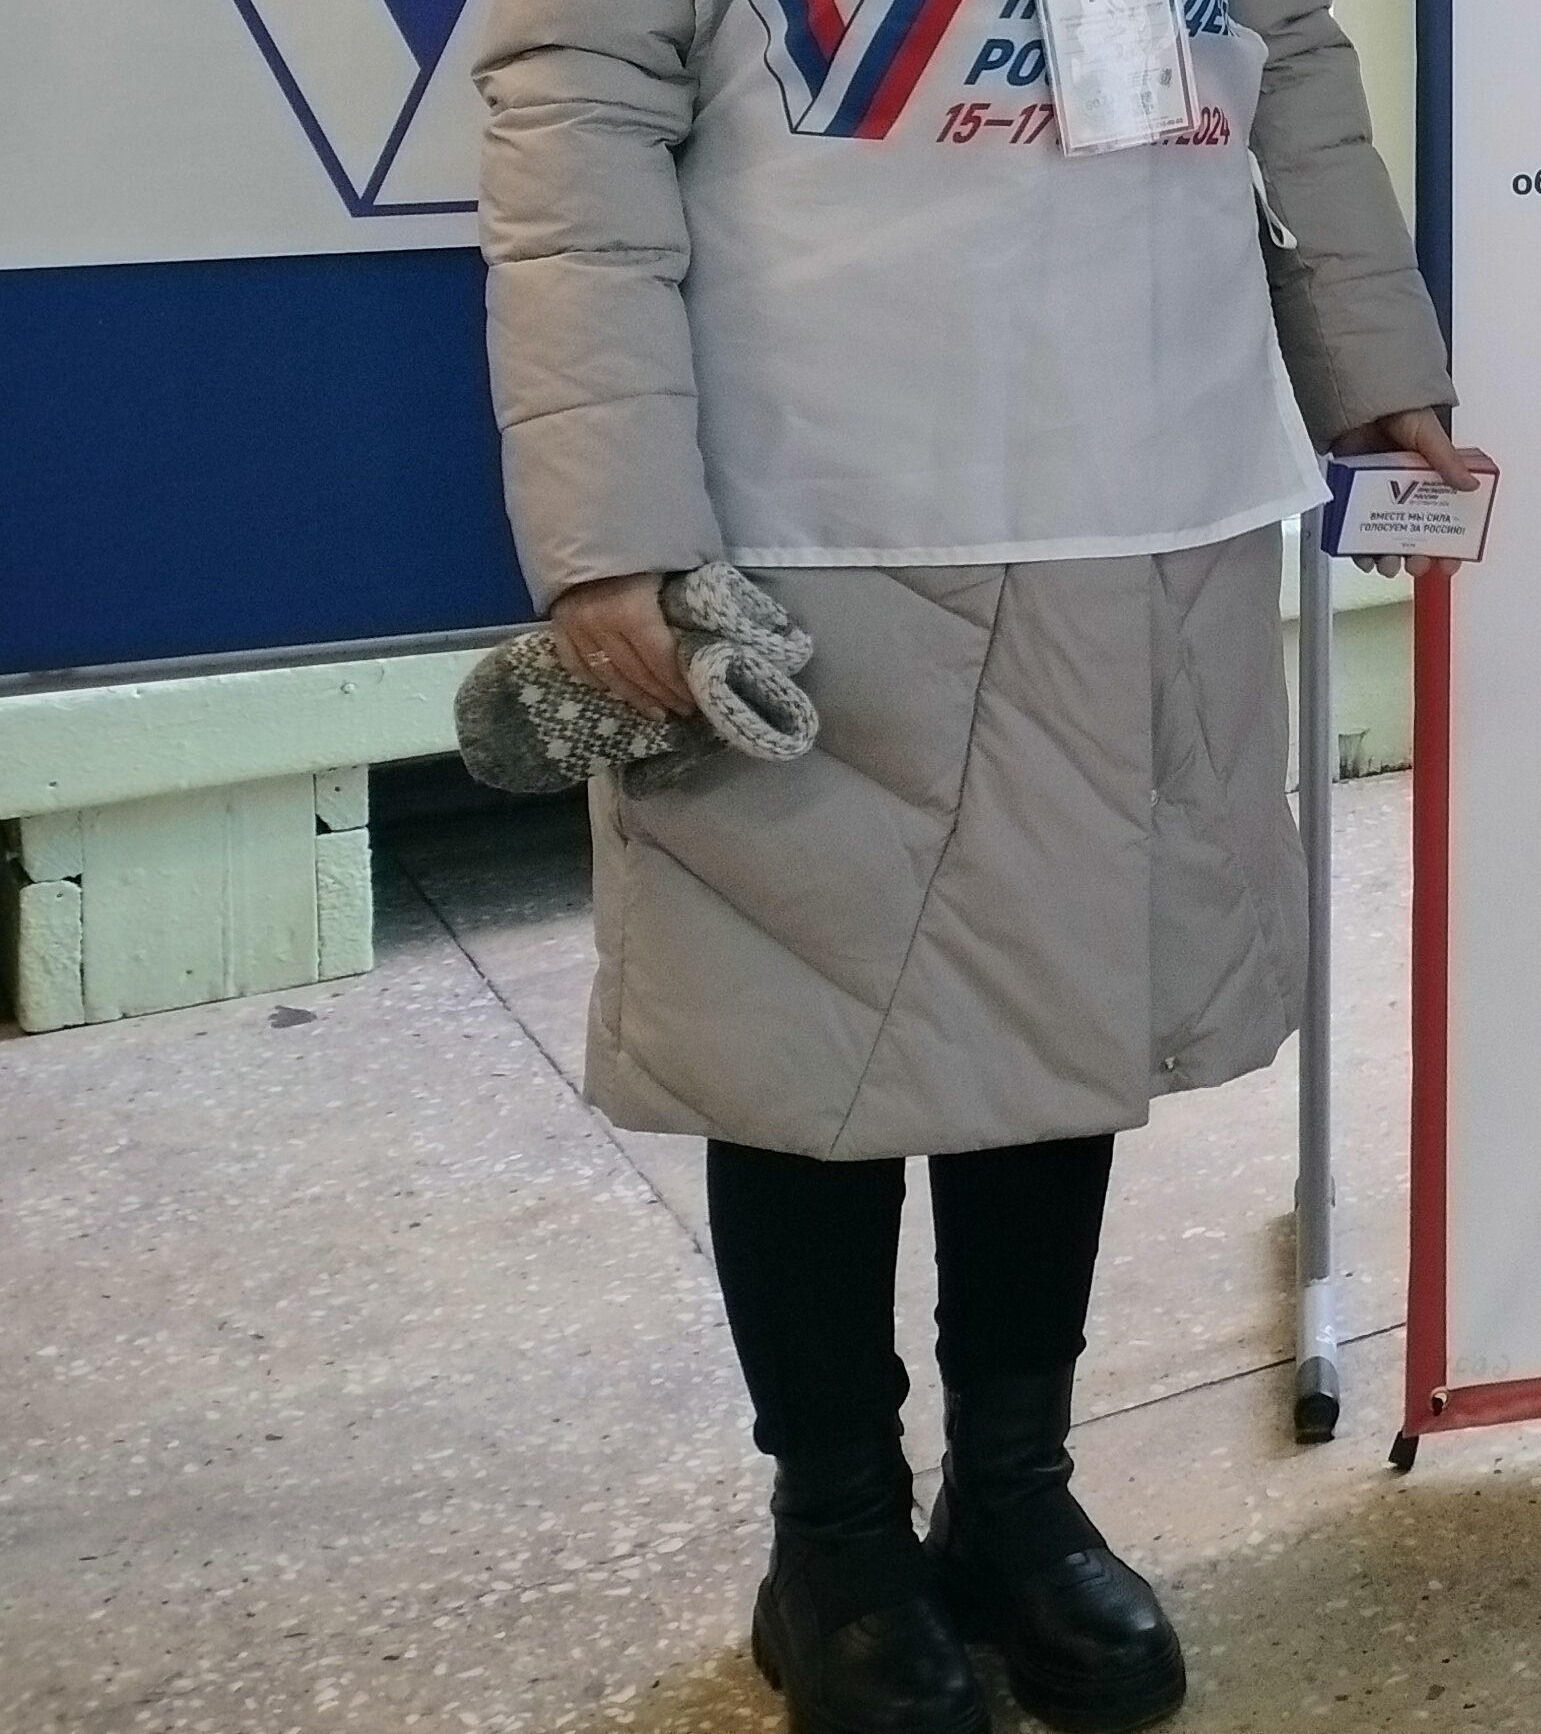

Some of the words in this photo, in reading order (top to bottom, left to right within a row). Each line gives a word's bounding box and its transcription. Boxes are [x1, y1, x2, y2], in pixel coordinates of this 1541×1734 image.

[1370, 512, 1406, 521] ВМЕСТЕ
[1408, 513, 1424, 521] МЫ
[1426, 513, 1451, 523] СИЛА
[1360, 523, 1407, 532] ГОЛОСУЕМ
[1409, 523, 1421, 533] ЗА
[1423, 524, 1466, 536] РОССИЮ!
